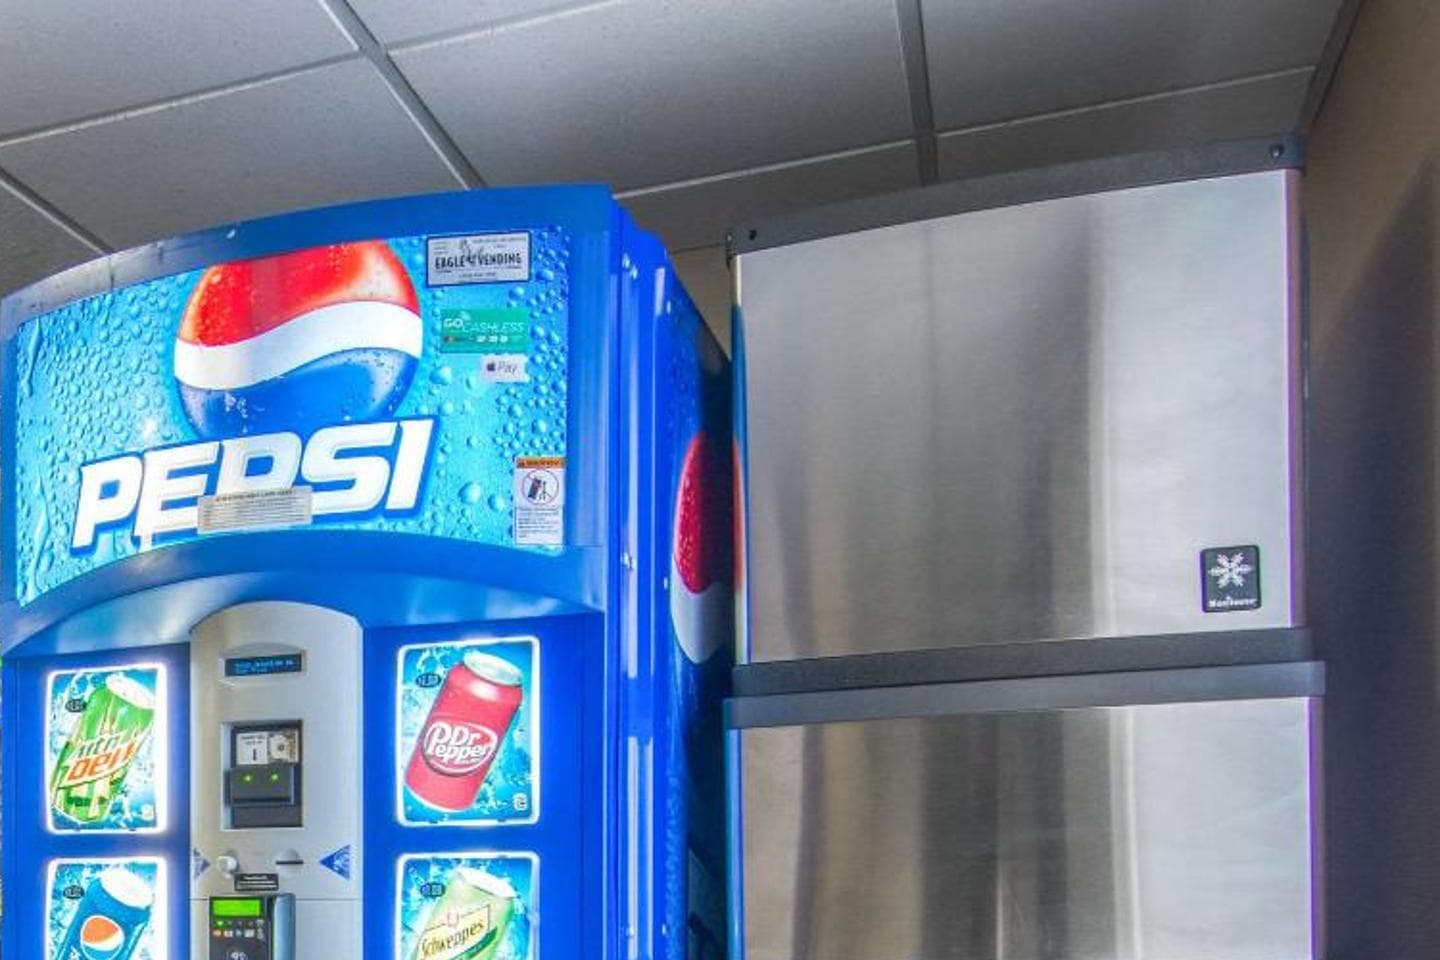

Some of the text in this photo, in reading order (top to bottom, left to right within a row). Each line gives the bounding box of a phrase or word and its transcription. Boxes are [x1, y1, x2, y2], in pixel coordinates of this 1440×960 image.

[478, 252, 522, 266] VENDING
[443, 317, 464, 328] GO
[71, 418, 435, 549] PEPSI
[425, 721, 492, 765] Pepper
